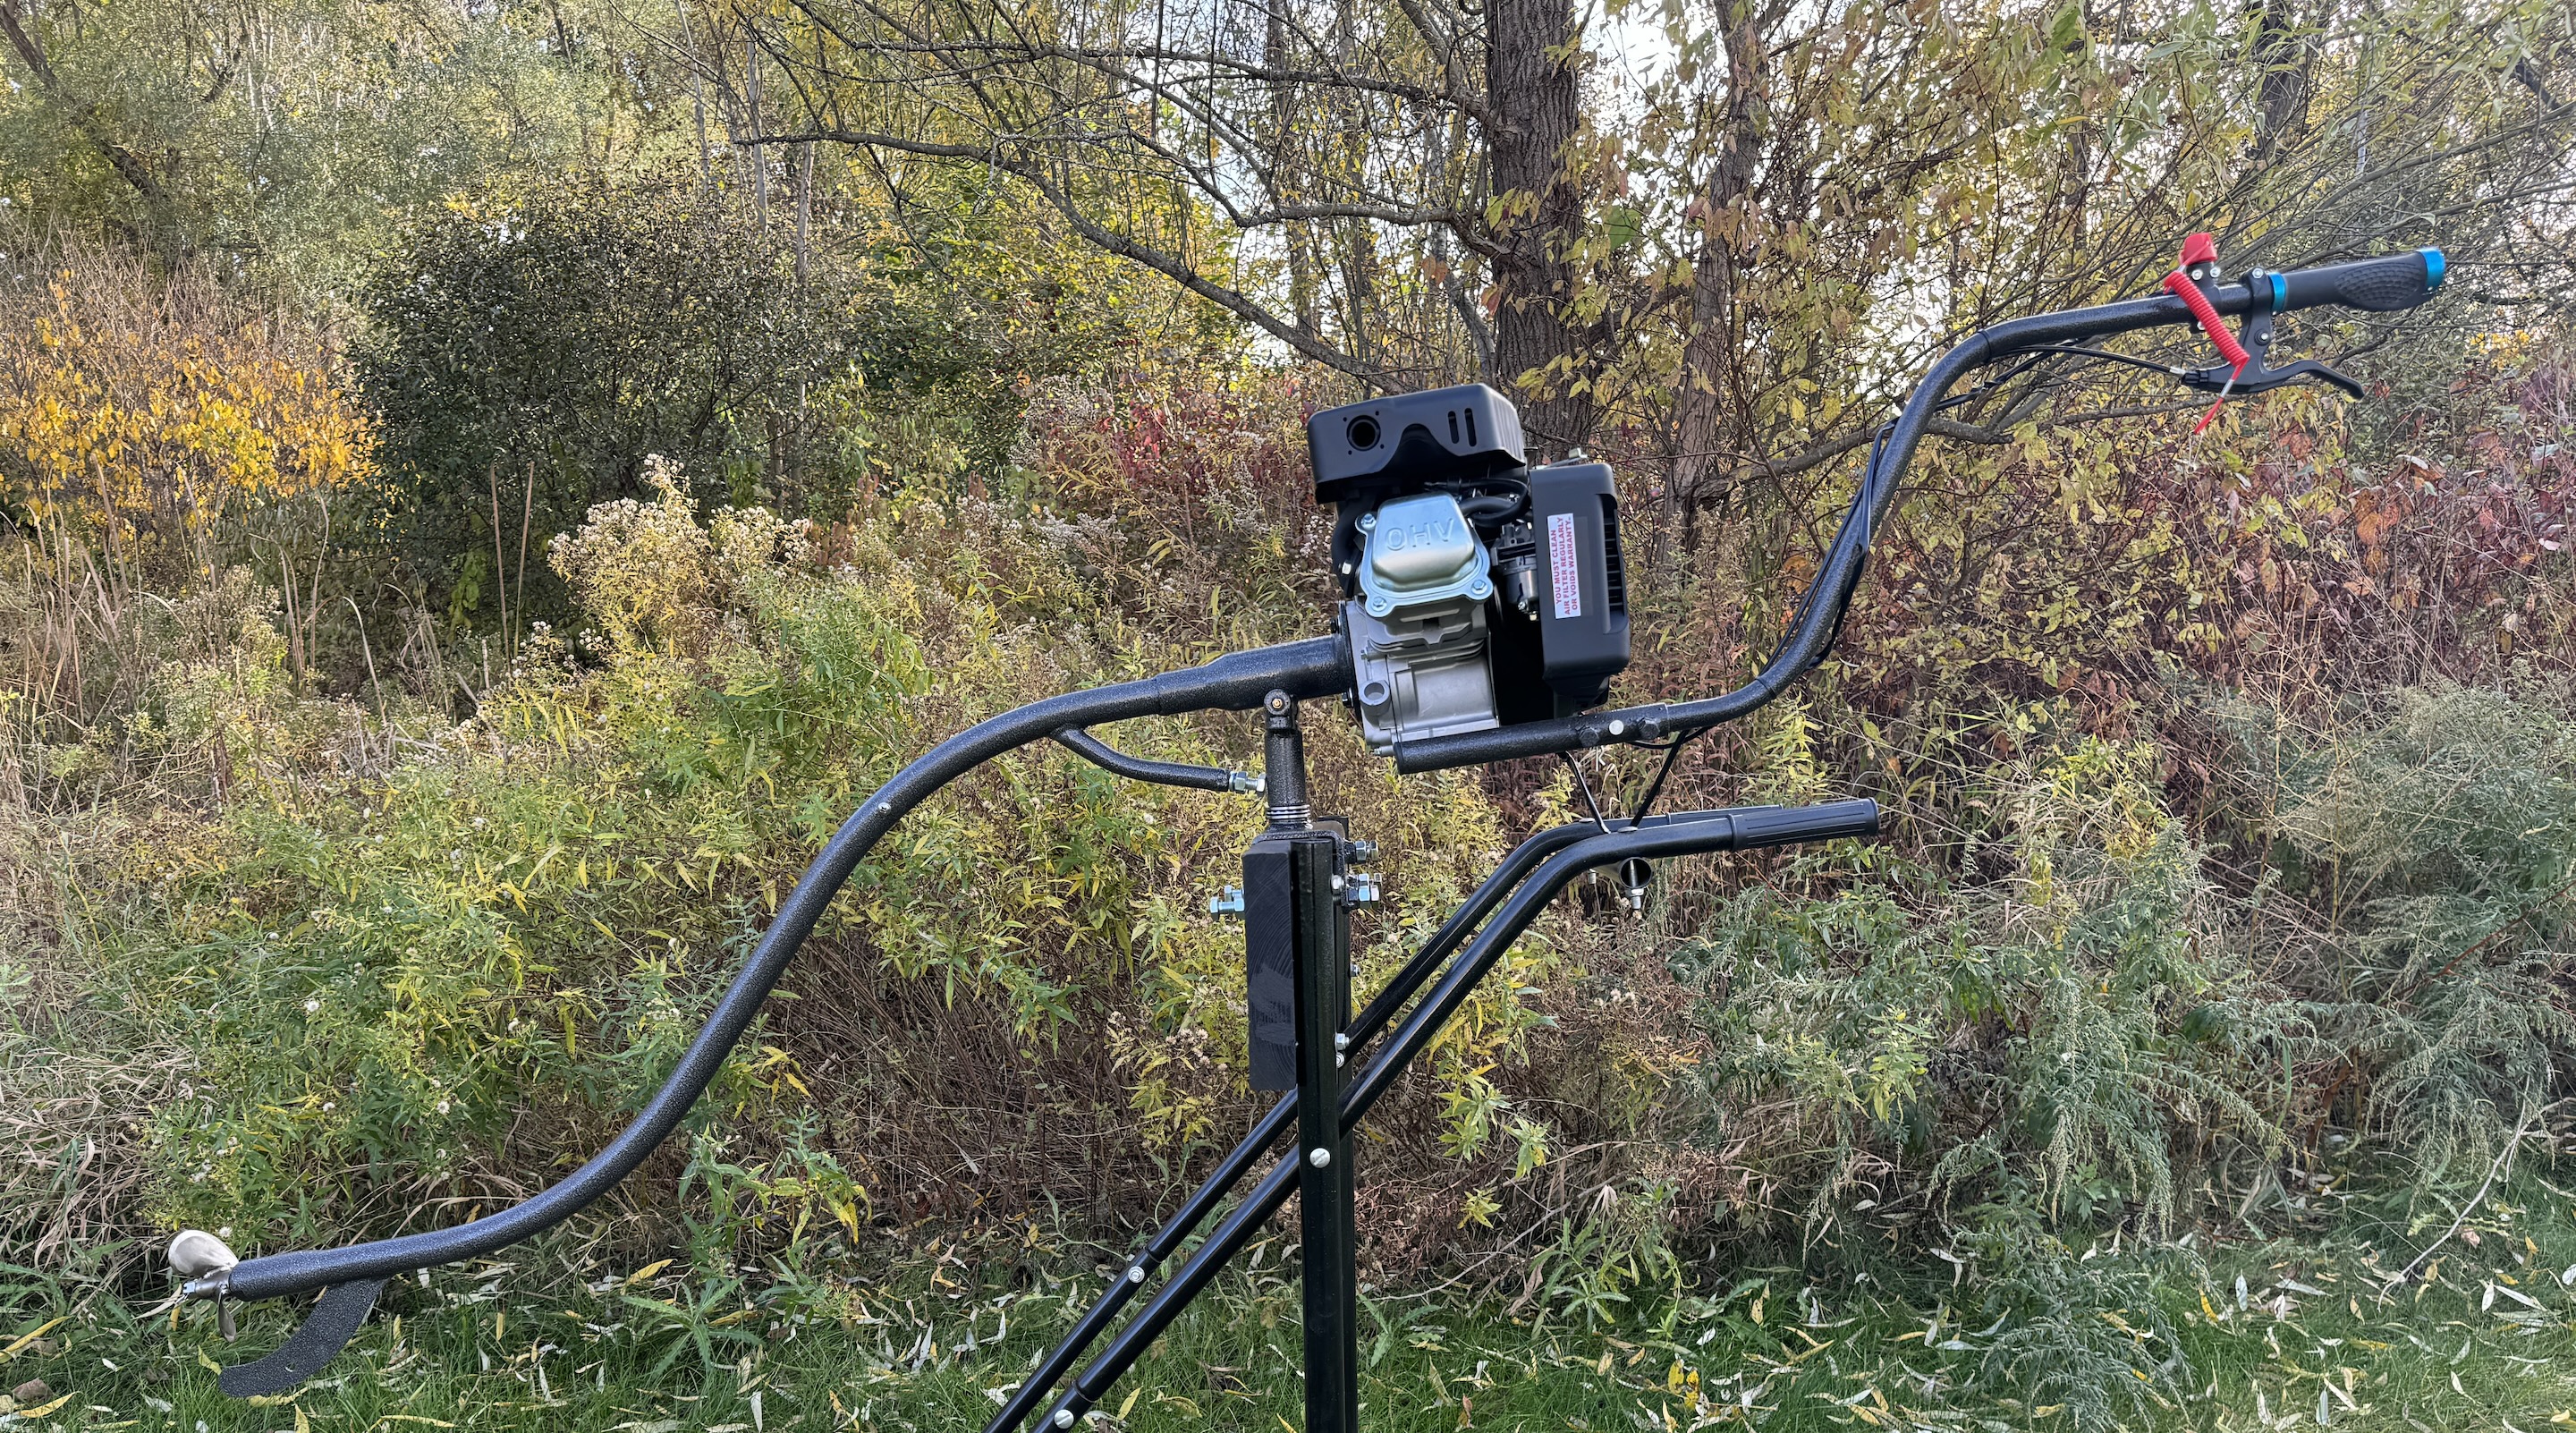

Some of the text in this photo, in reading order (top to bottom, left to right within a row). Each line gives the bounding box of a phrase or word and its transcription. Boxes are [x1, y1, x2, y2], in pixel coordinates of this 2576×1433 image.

[1385, 517, 1454, 551] OHV
[1550, 530, 1558, 557] CLEAN
[1557, 517, 1566, 567] REGULARLY
[1561, 570, 1569, 598] FILTER
[1572, 598, 1578, 610] OR
